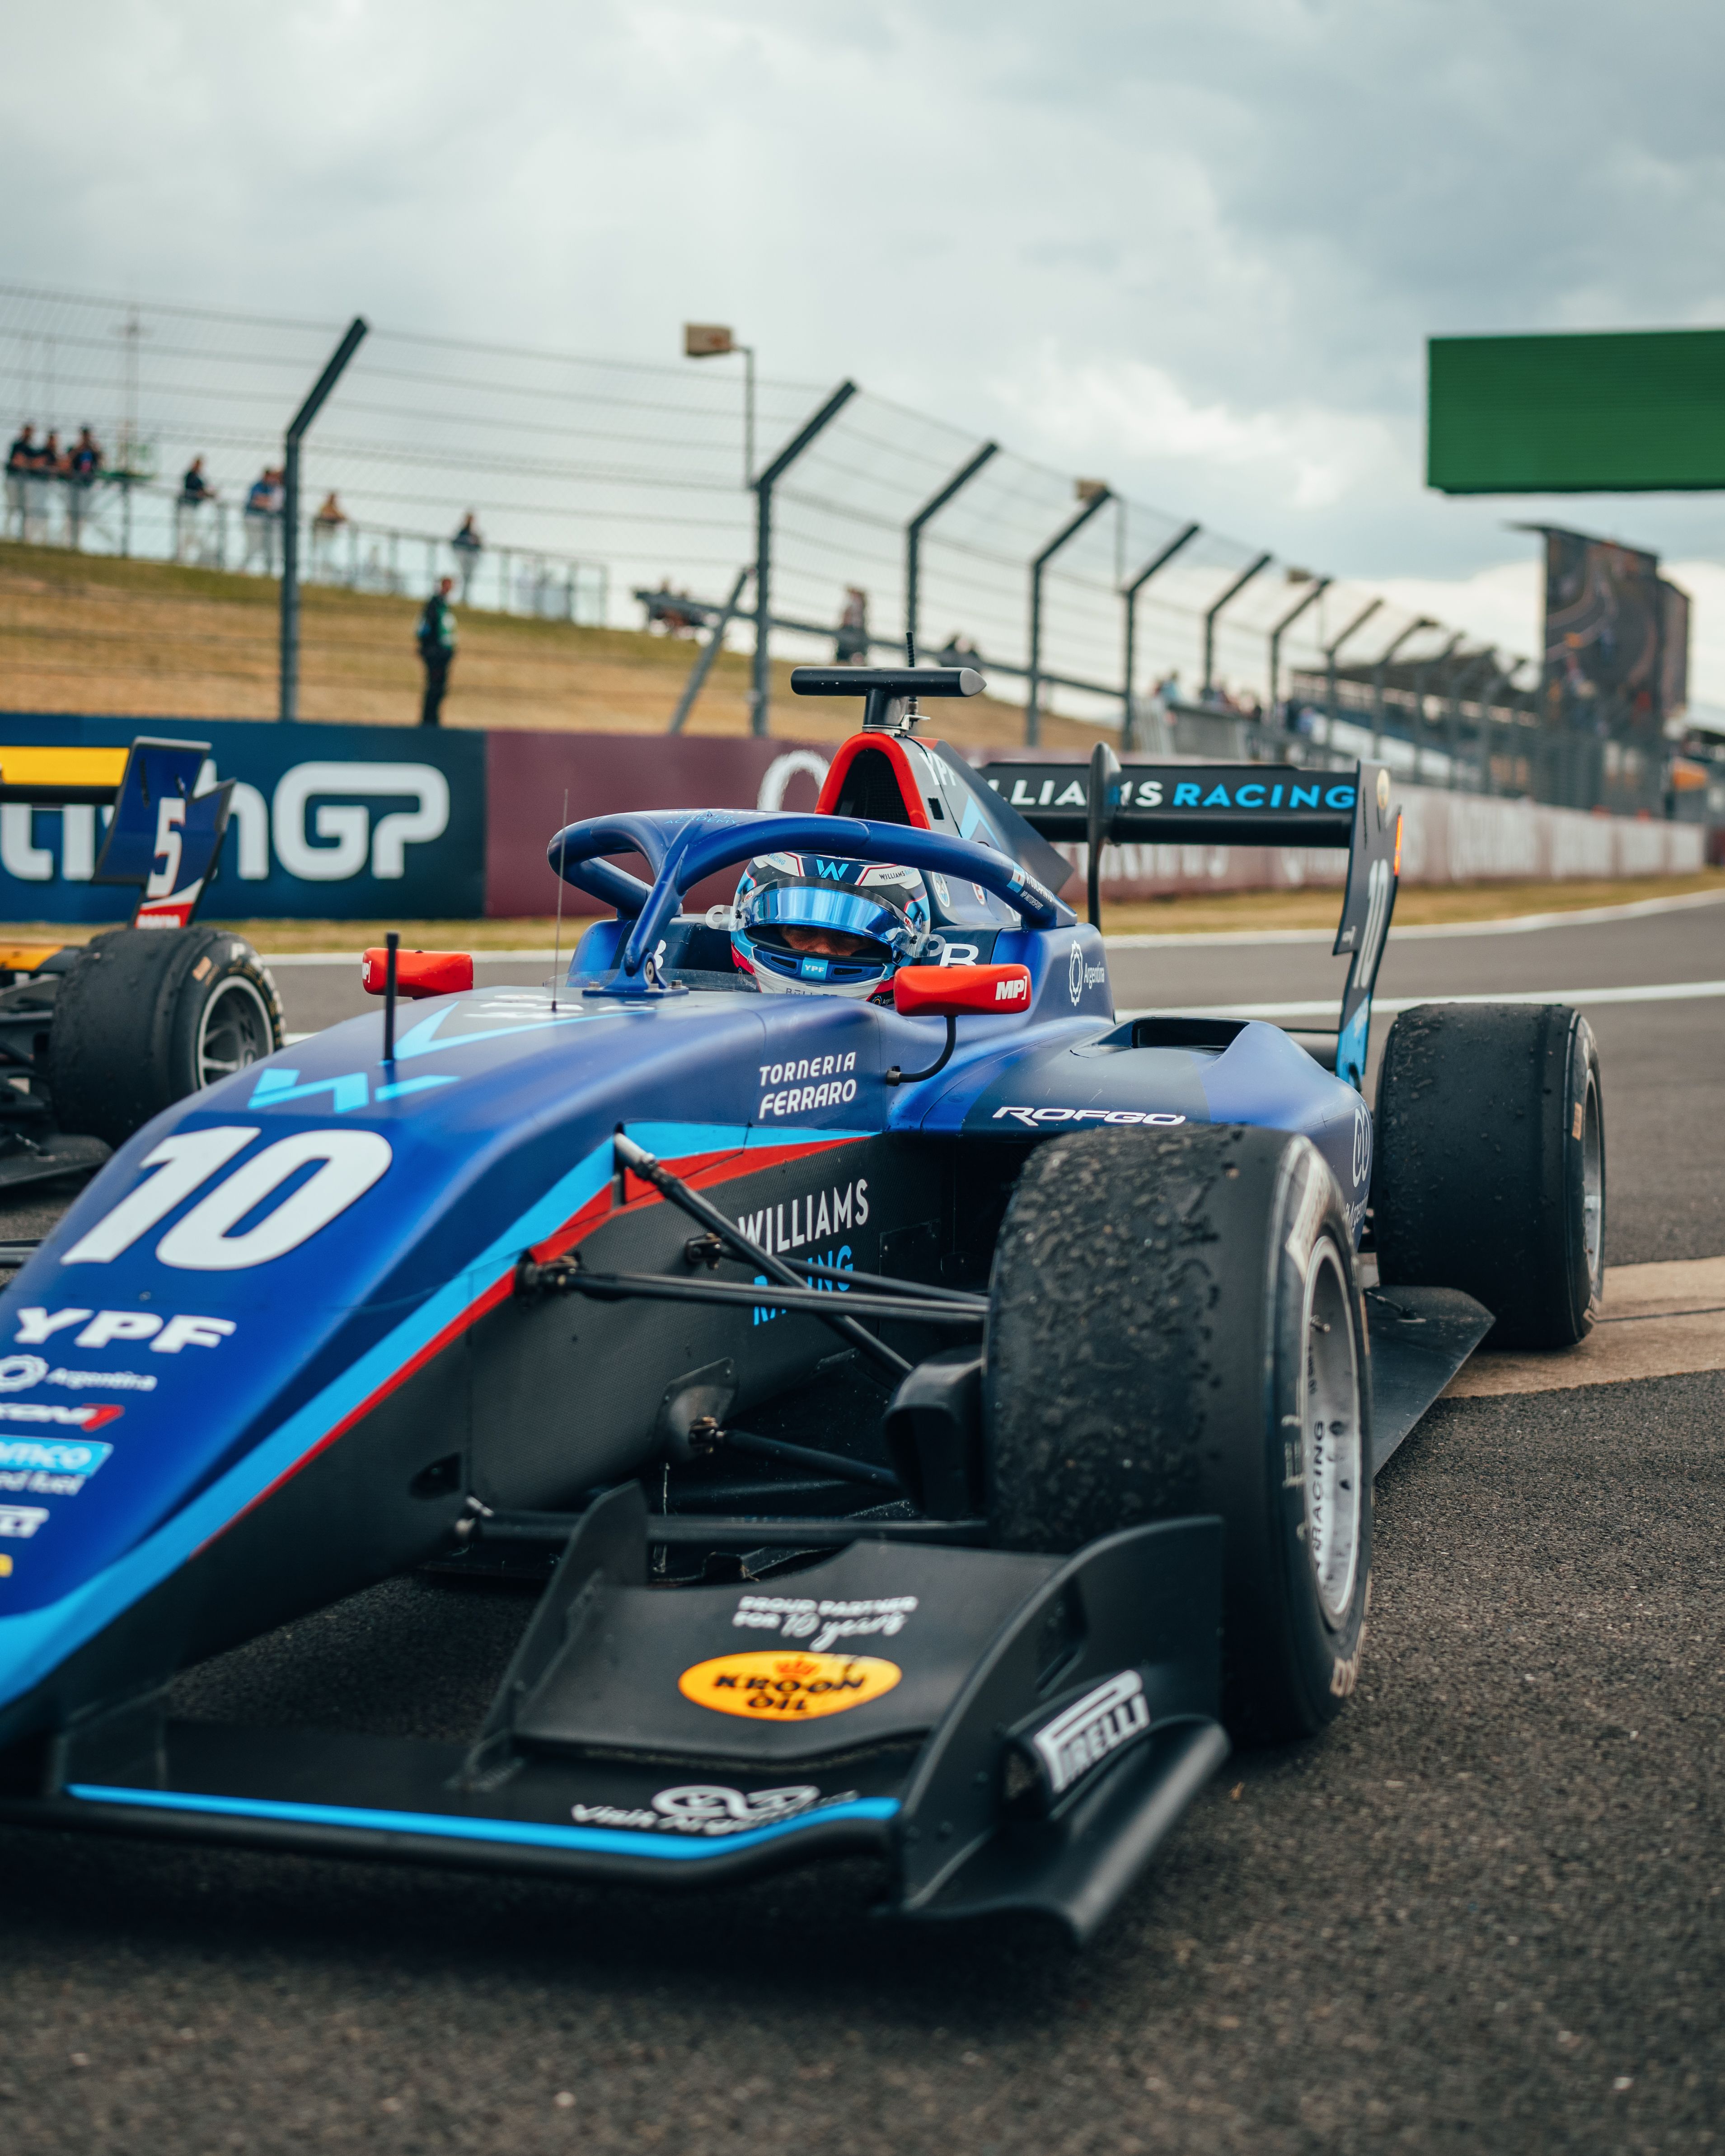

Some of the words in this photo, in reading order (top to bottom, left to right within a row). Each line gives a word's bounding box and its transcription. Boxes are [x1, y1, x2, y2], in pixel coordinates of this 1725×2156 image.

[1172, 781, 1355, 810] RACING
[146, 797, 185, 899] 5
[878, 870, 905, 881] WILLIAMS
[745, 891, 754, 900] BELL
[1024, 893, 1044, 910] MOTORSPORT
[904, 917, 912, 928] BELL
[804, 964, 825, 973] YPF
[1083, 961, 1105, 989] Argentina
[759, 1051, 857, 1086] TORNERIA
[758, 1078, 857, 1120] FERRARO
[992, 1106, 1186, 1127] ROFGO
[61, 1125, 393, 1271] 10
[738, 1178, 869, 1256] WILLIAMS
[754, 1245, 854, 1326] RING
[14, 1307, 237, 1354] YPF
[46, 1367, 158, 1392] Argentina
[1309, 1420, 1324, 1543] RACING
[739, 1595, 817, 1613] PROUD
[817, 1595, 919, 1613] PARTNER
[732, 1612, 782, 1628] FOR
[809, 1611, 908, 1652] years
[713, 1673, 867, 1693] KROON
[746, 1694, 809, 1711] OIL
[1034, 1669, 1151, 1794] PIRELLI
[571, 1804, 658, 1828] Visit
